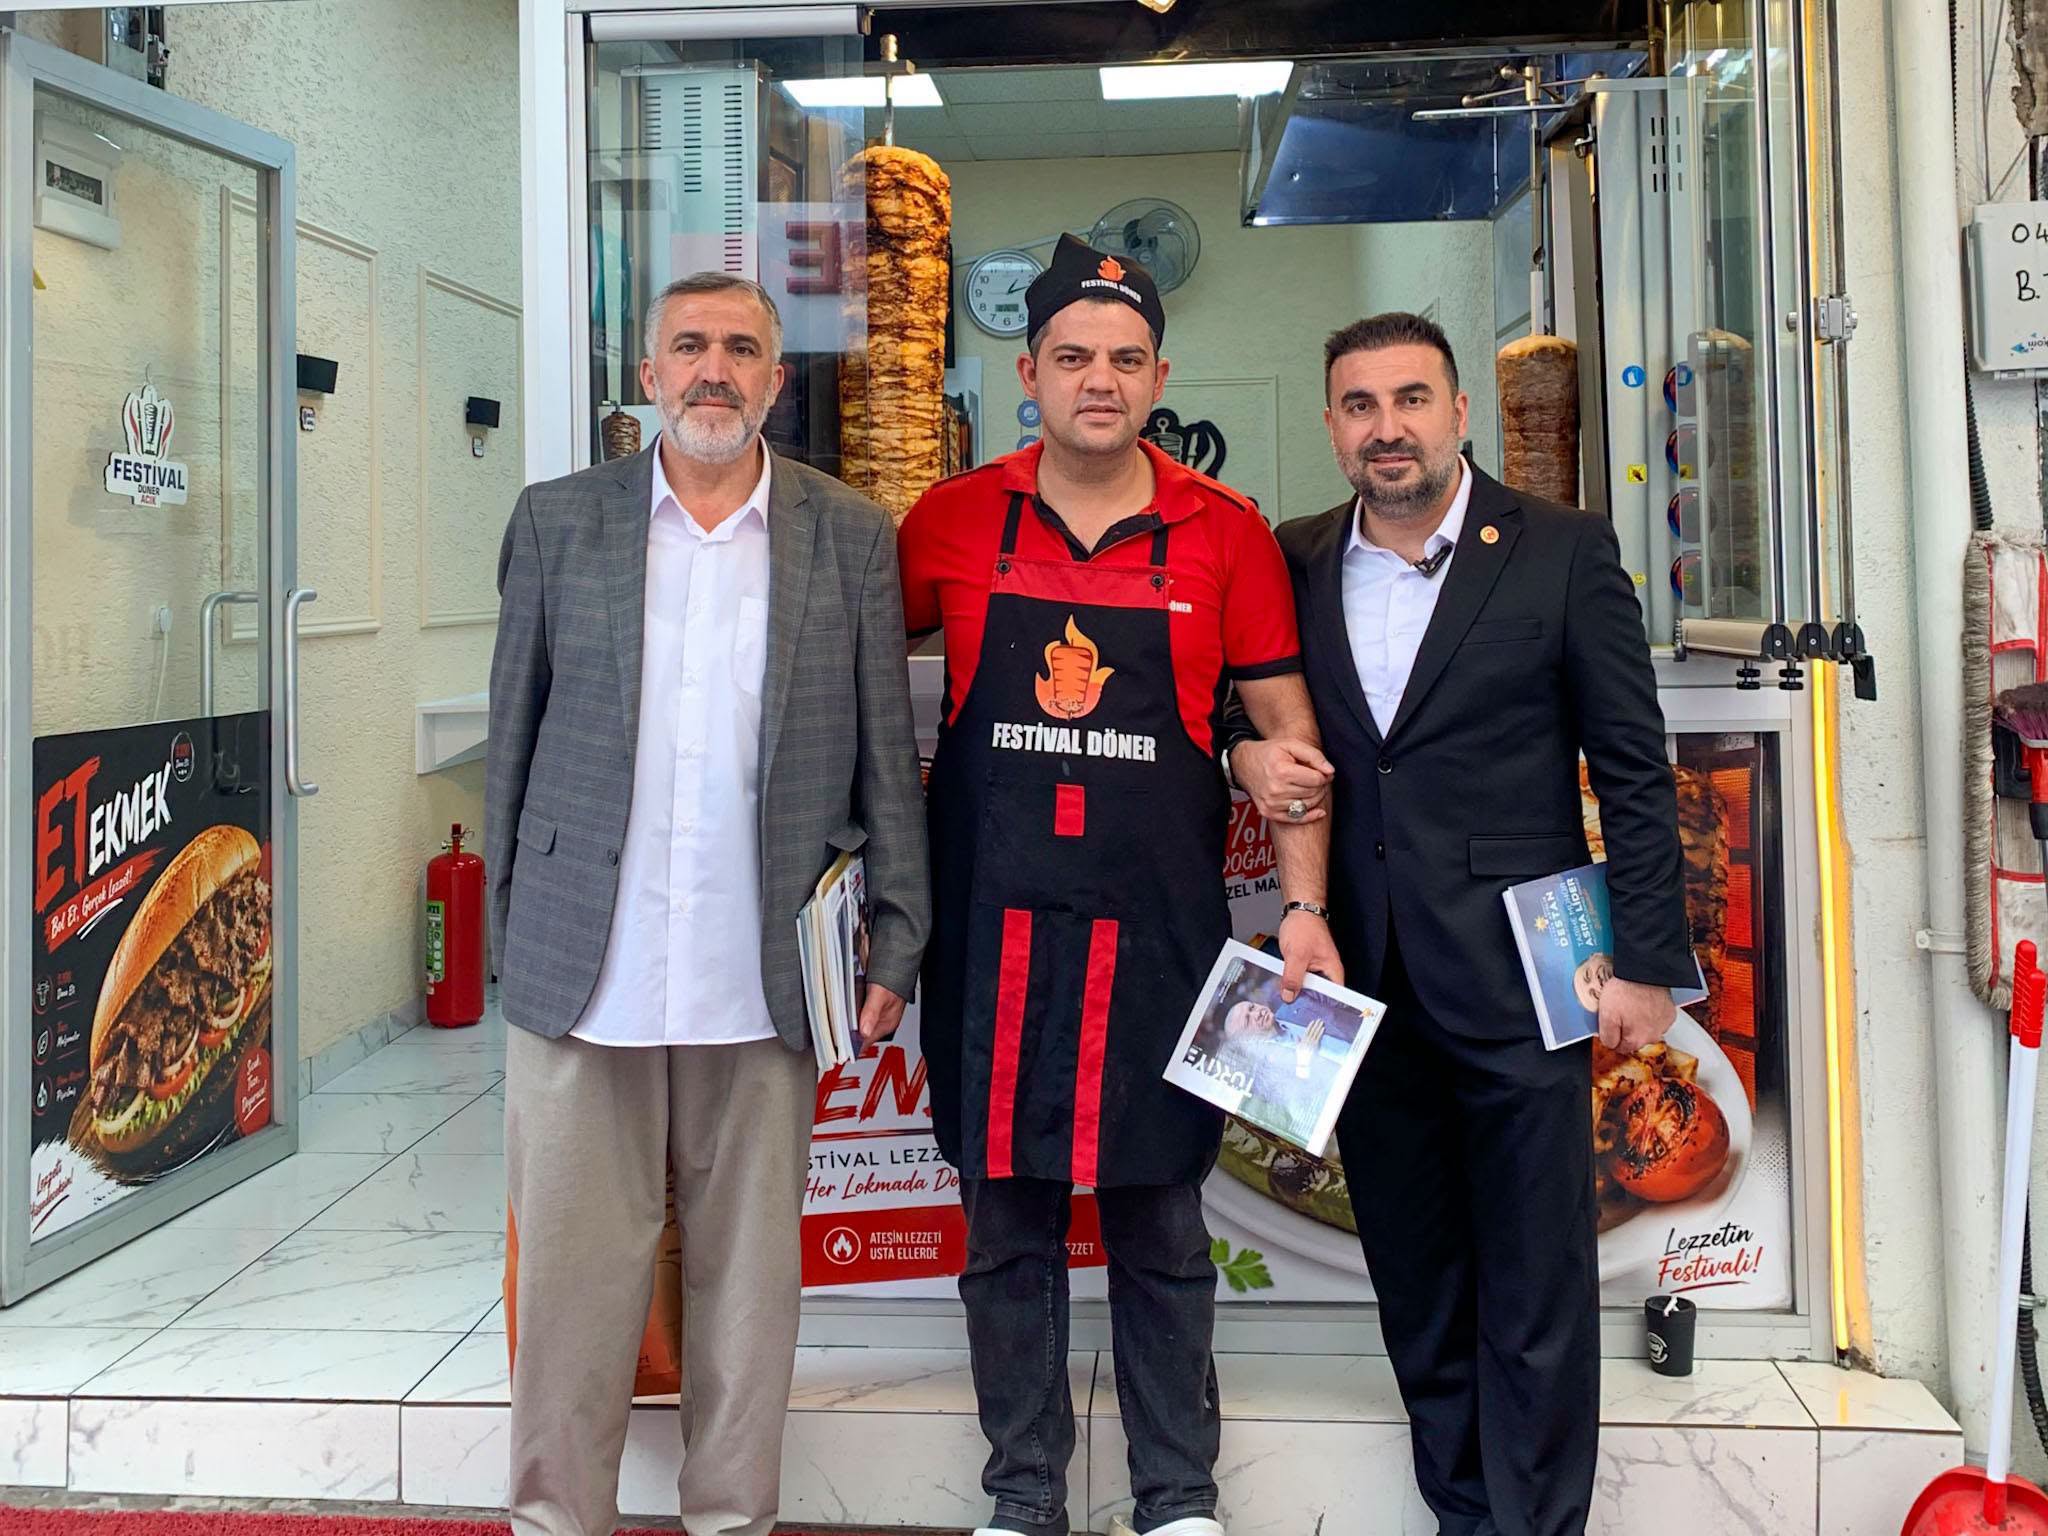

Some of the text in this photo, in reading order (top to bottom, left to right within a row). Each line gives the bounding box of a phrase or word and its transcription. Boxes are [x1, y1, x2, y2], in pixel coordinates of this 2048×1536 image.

[980, 275, 990, 284] 10
[975, 288, 983, 298] 9
[979, 302, 987, 312] 8
[990, 313, 997, 322] 7
[1003, 317, 1011, 326] 6
[1018, 313, 1025, 322] 5
[113, 458, 185, 490] FESTİVAL
[1168, 600, 1192, 614] ÖNER
[991, 721, 1156, 763] FESTİVAL DÖNER
[34, 755, 172, 914] ET EKMEK
[1254, 876, 1281, 895] MA
[50, 912, 65, 940] Bol
[82, 884, 107, 918] Gerçek
[107, 864, 134, 898] Lezzet!
[1545, 890, 1569, 948] DESTAN
[814, 1044, 932, 1126] EN
[805, 1166, 962, 1204] Her Lokmada Do
[869, 1228, 942, 1245] ATEŞİN LEZZETİ
[1664, 1221, 1754, 1260] Lezzetin
[869, 1246, 939, 1261] USTA ELLERDE
[1658, 1245, 1764, 1288] Festivali!
